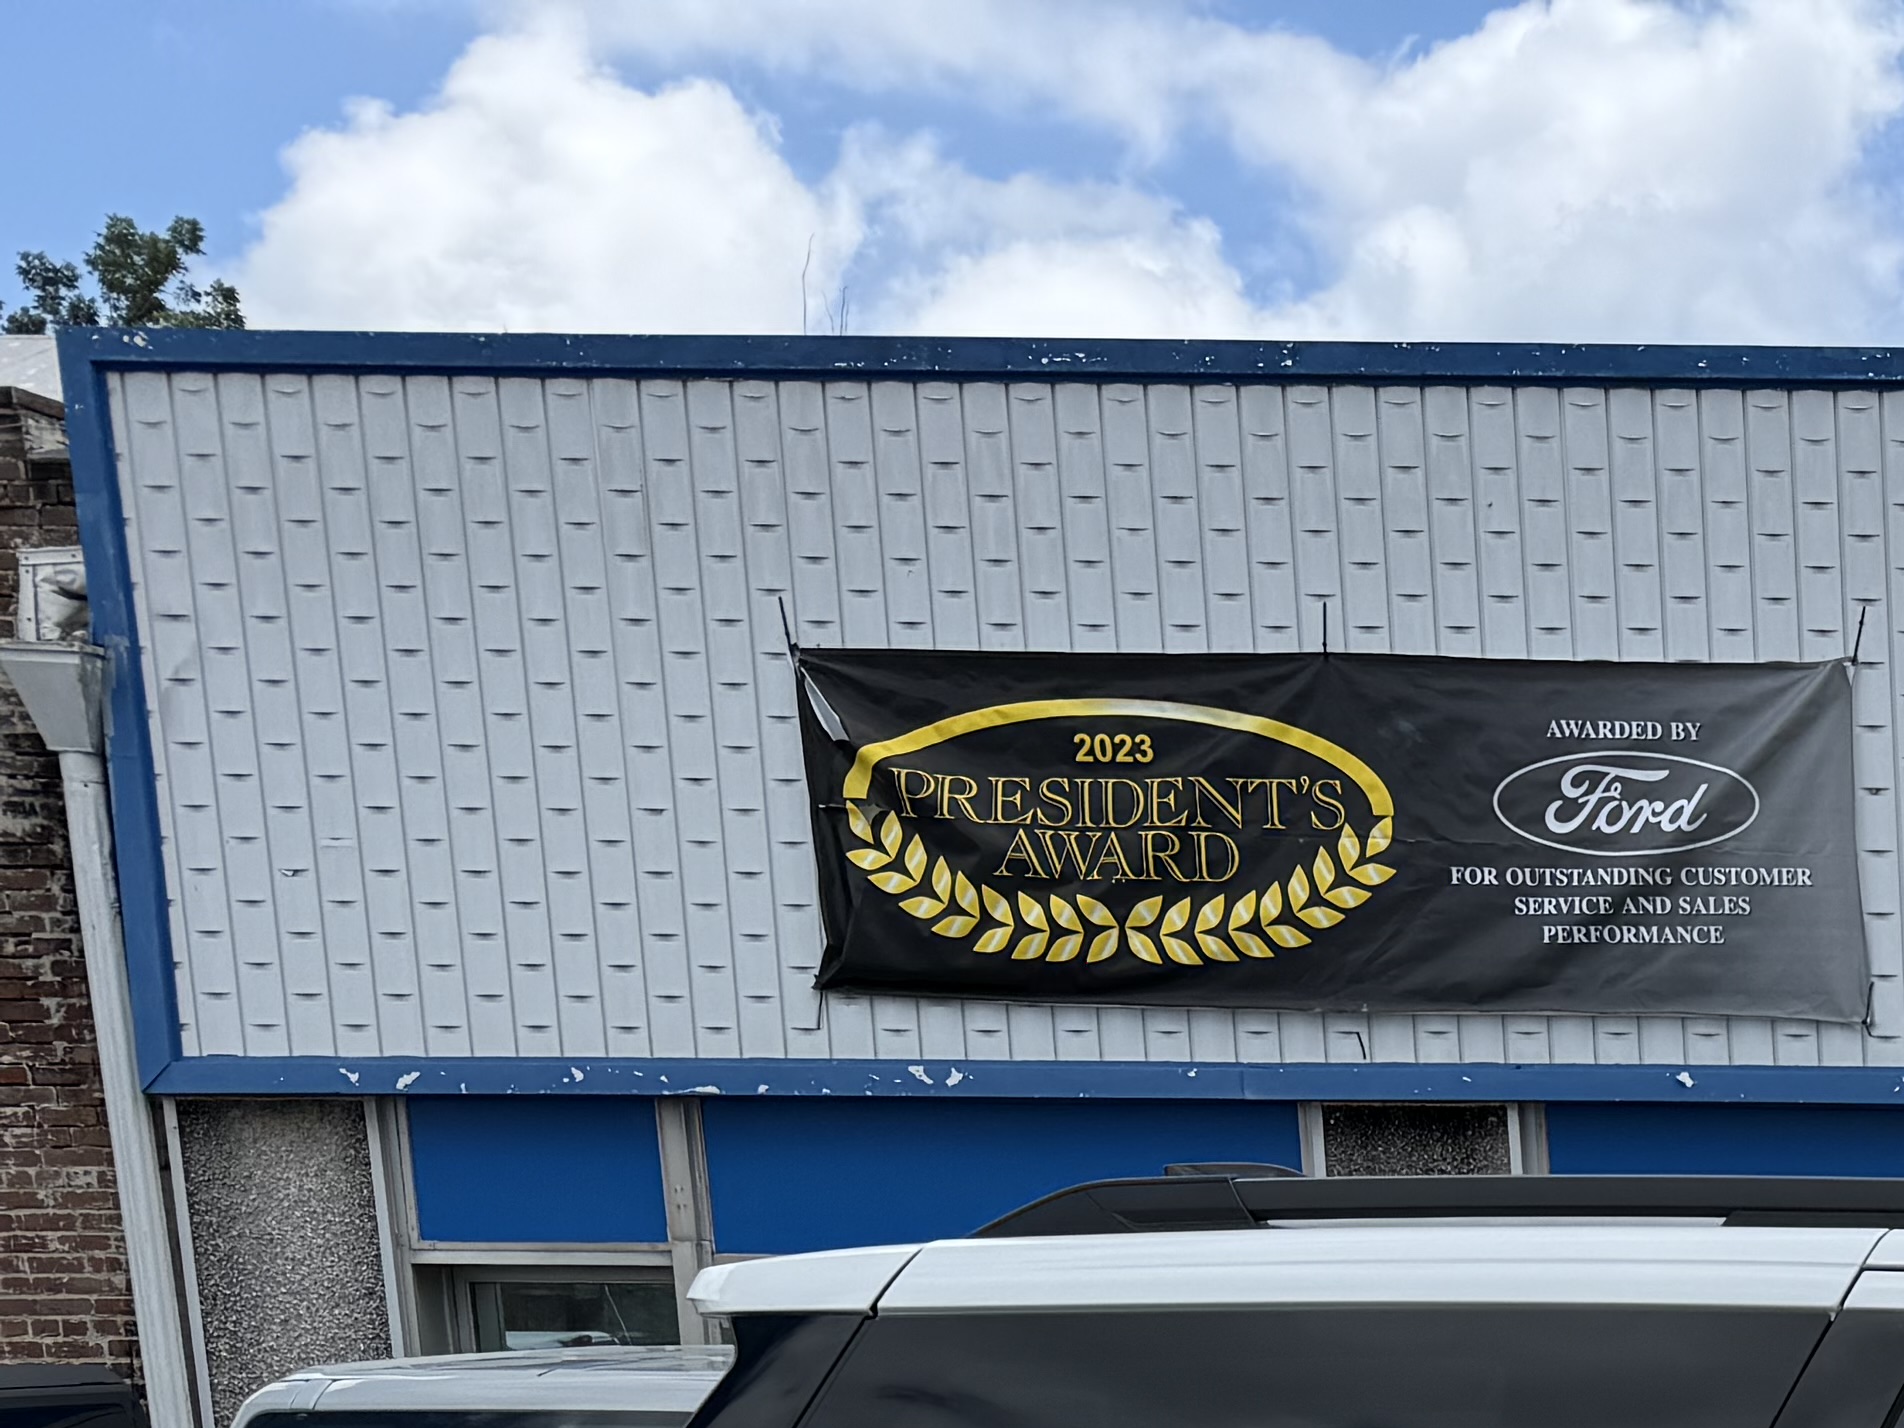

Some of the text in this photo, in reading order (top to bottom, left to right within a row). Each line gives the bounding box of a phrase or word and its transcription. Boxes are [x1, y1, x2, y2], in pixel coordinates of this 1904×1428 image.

[1546, 720, 1702, 742] AWARDED BY
[1073, 733, 1154, 763] 2023
[888, 767, 1346, 830] PRESIDENT'S
[1544, 764, 1709, 834] Ford
[992, 828, 1240, 883] AWARD
[1450, 866, 1813, 887] FOR OUTSTANDING CUSTOMER
[1514, 896, 1752, 916] SERVICE AND SALES
[1542, 925, 1726, 945] PERFORMANCE
